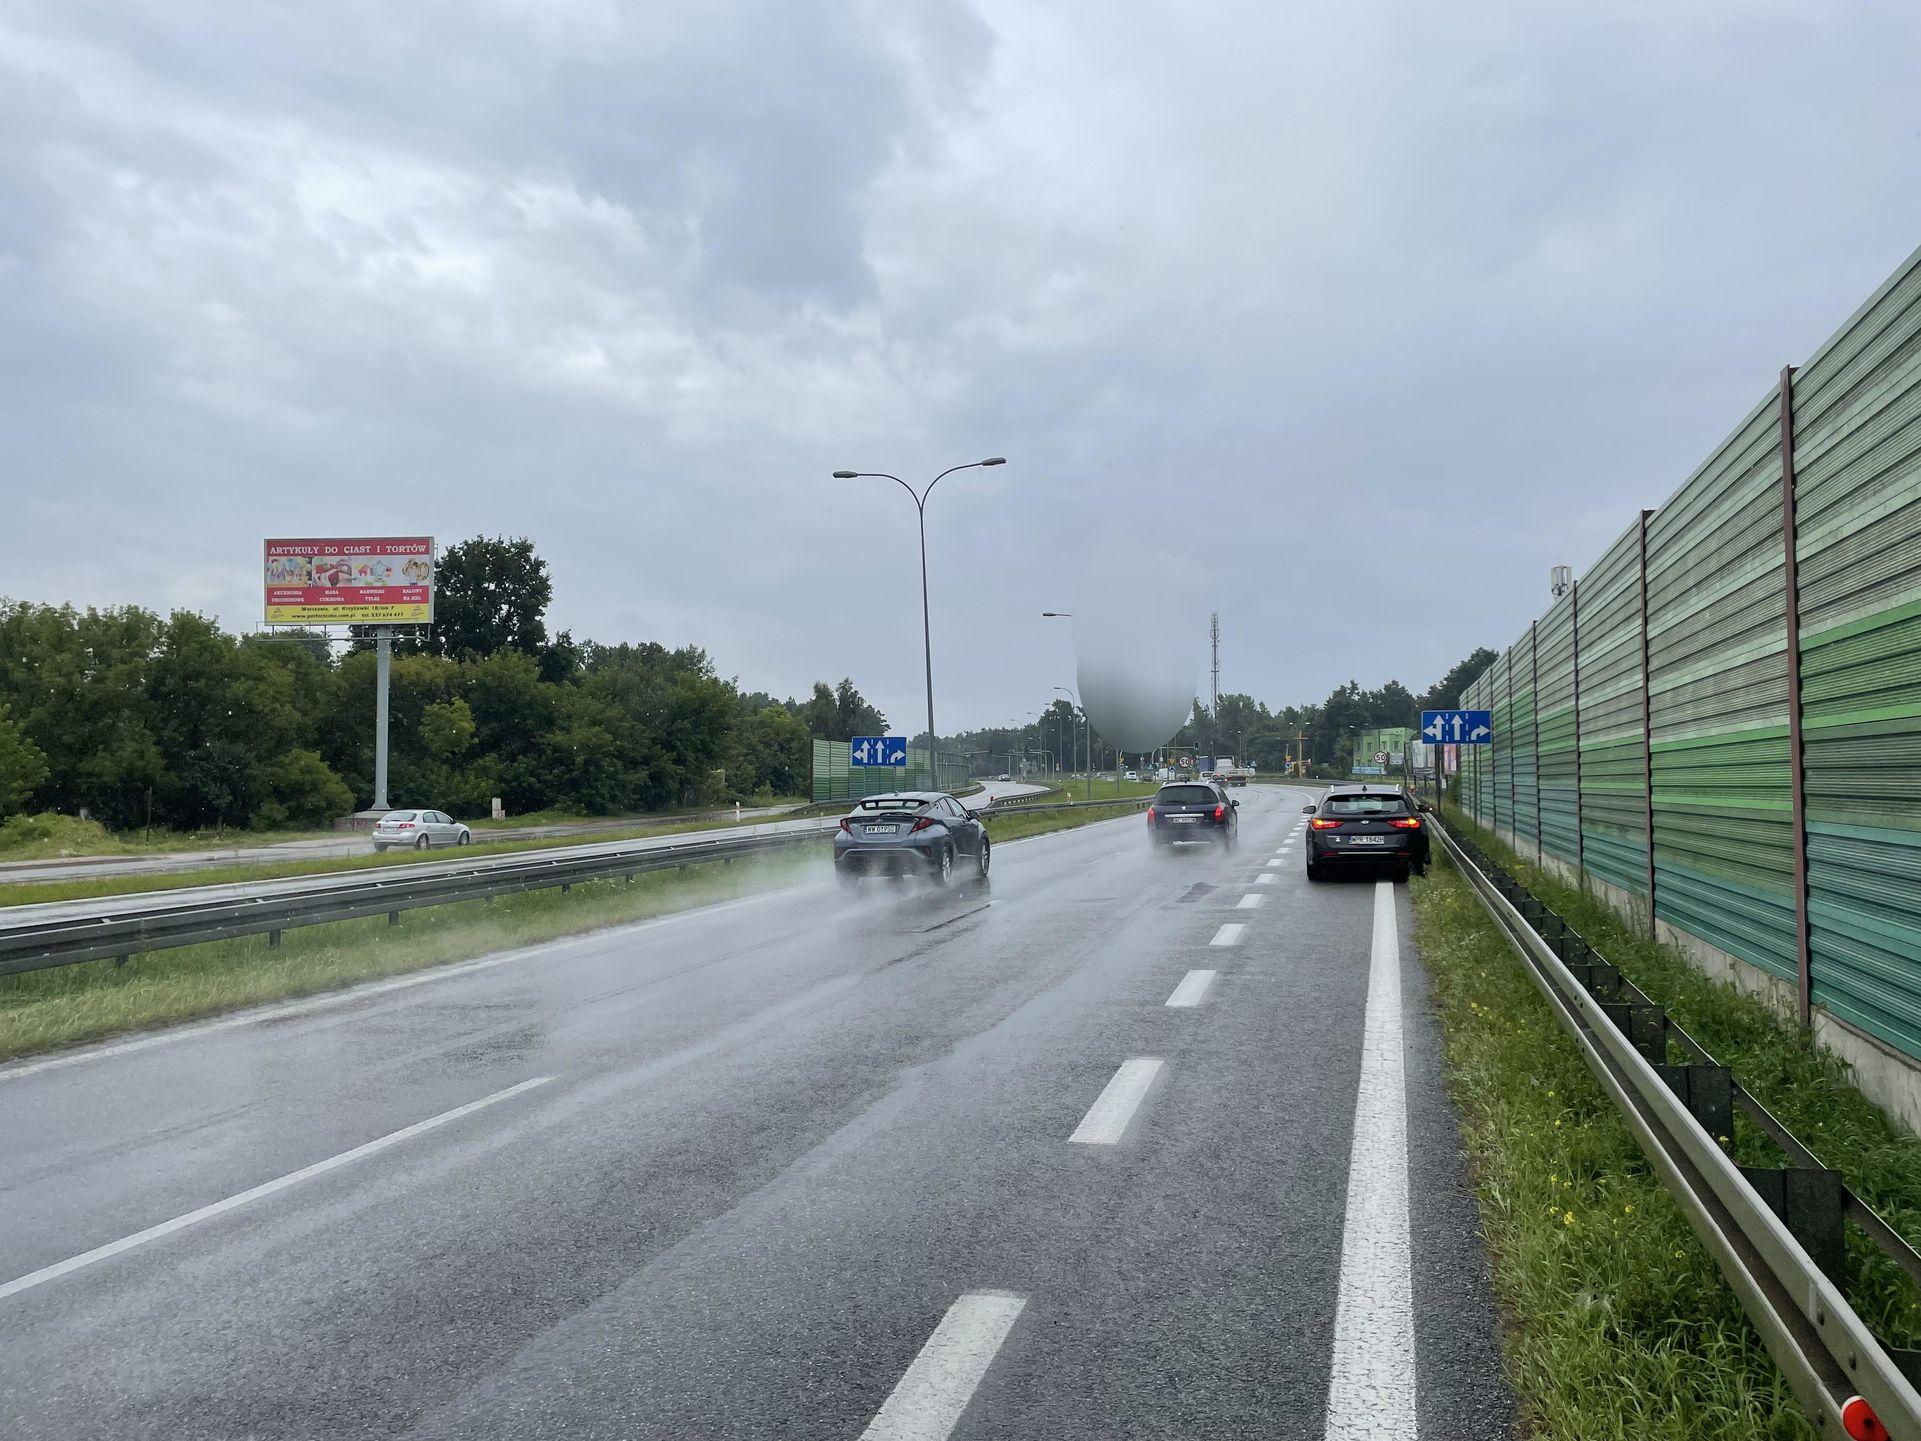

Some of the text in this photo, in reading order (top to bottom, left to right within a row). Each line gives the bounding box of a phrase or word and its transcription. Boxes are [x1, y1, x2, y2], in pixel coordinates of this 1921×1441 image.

[325, 546, 338, 554] DO
[343, 545, 371, 553] CIAST
[376, 545, 381, 553] I
[386, 544, 426, 553] TORTÓW
